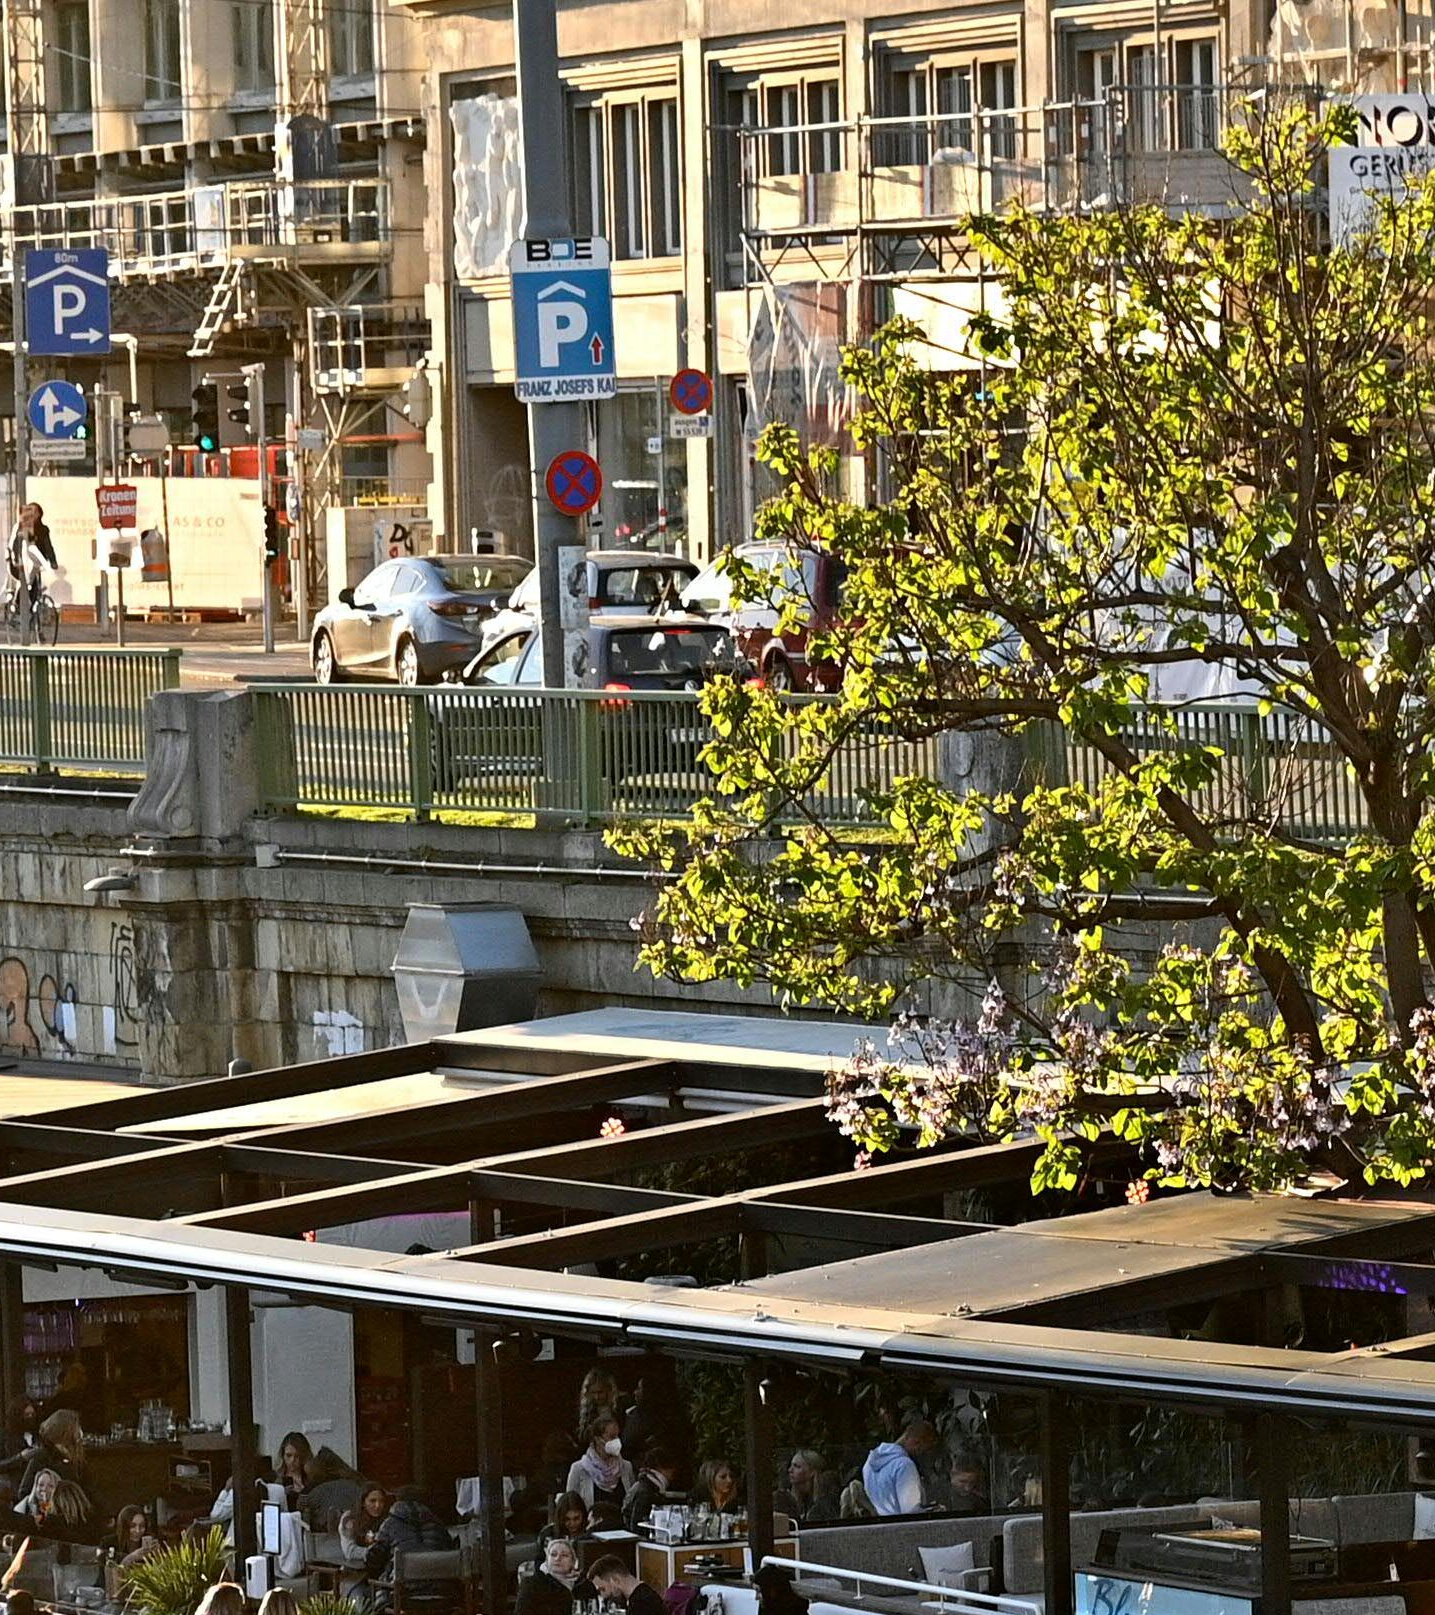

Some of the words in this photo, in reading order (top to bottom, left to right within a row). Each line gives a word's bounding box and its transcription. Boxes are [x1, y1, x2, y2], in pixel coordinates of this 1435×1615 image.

[53, 285, 86, 336] P
[538, 301, 589, 368] P
[517, 381, 552, 397] FRANZ
[554, 378, 595, 396] JOSEFS
[98, 489, 137, 504] Kronen
[100, 503, 136, 517] Zeitung
[206, 516, 225, 528] CO
